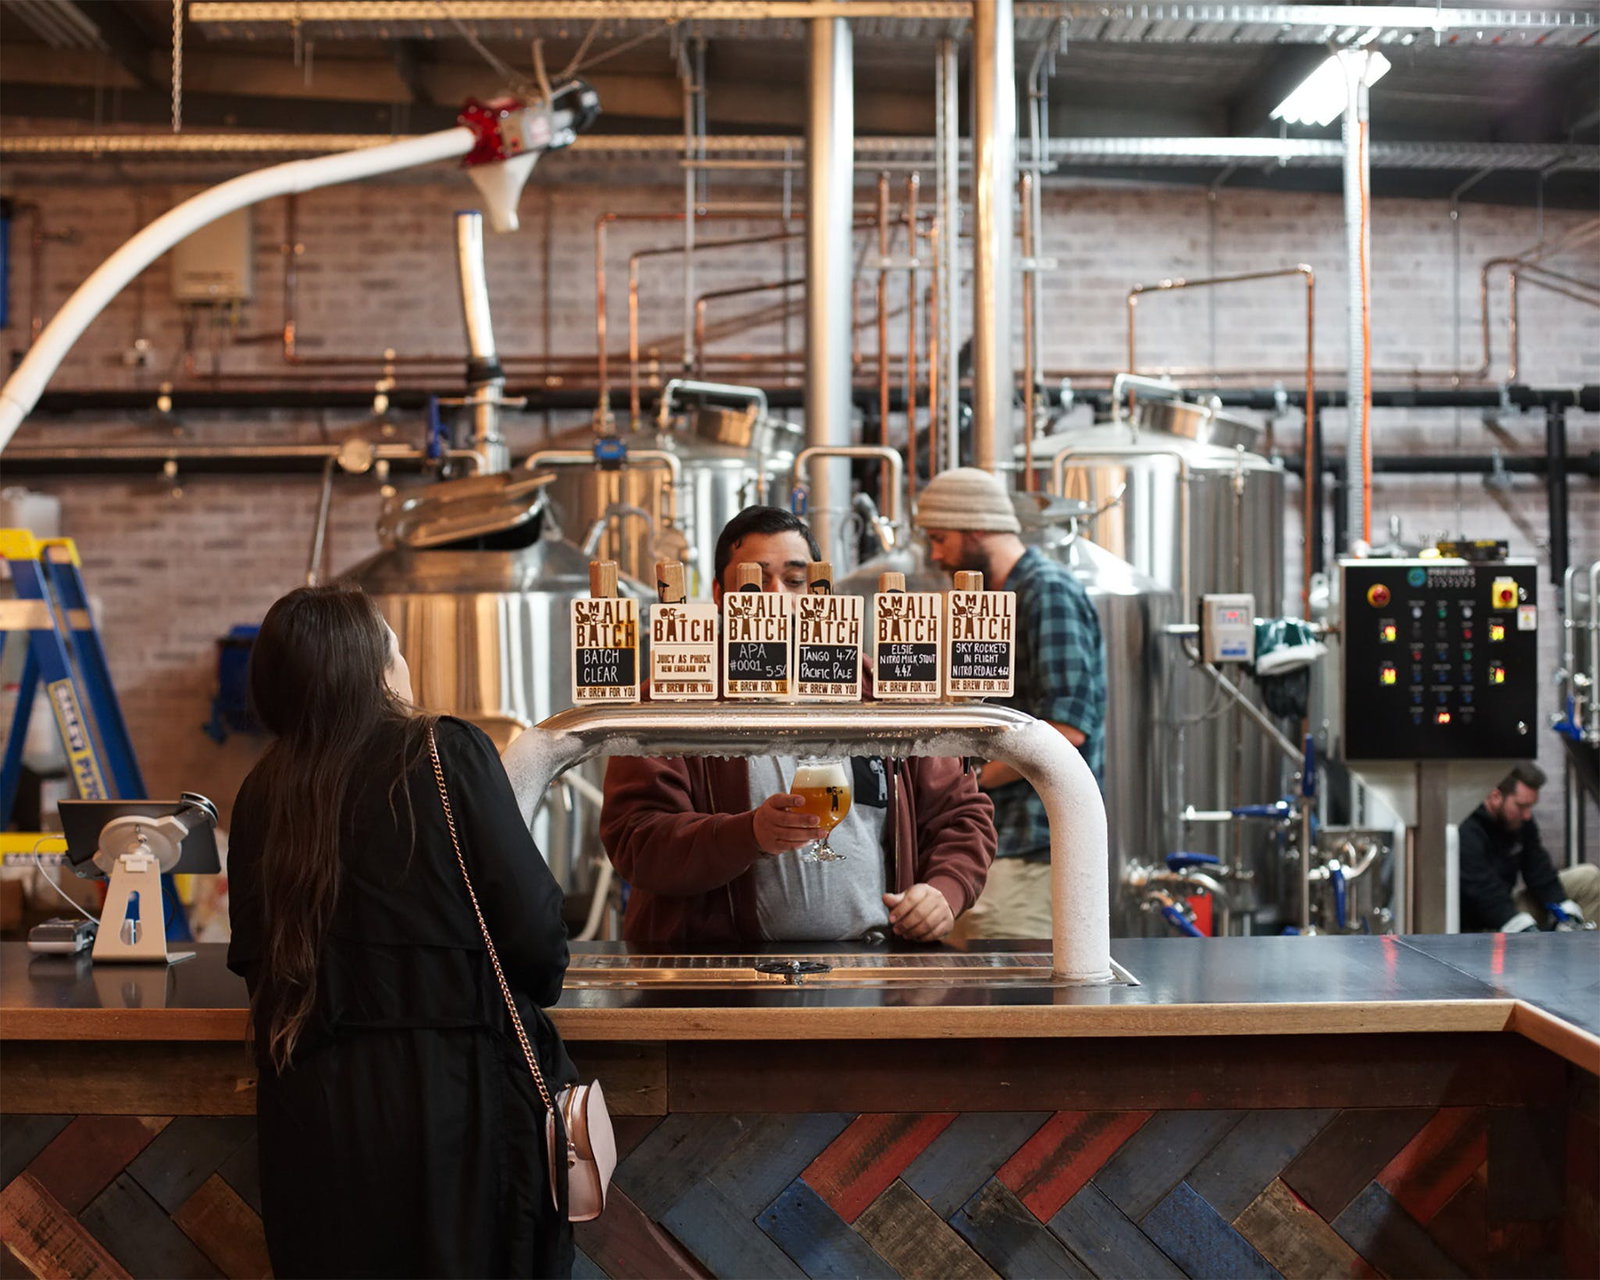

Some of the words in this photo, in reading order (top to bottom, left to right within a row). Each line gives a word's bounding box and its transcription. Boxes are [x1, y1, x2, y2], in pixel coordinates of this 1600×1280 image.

[728, 595, 787, 618] SMALL
[800, 597, 859, 621] SMALL
[878, 596, 937, 619] SMALL
[952, 594, 1011, 617] SMALL
[575, 601, 635, 625] SMALL
[576, 624, 635, 647] BATCH
[654, 619, 714, 642] BATCH
[729, 618, 787, 641] BATCH
[800, 620, 858, 644] BATCH
[879, 619, 937, 642] BATCH
[952, 617, 1011, 640] BATCH
[739, 643, 767, 659] APA
[891, 644, 914, 655] ELSIE
[956, 643, 973, 654] SKY
[974, 643, 1007, 654] ROCKETS
[583, 649, 620, 665] BATCH
[678, 654, 687, 664] AS
[879, 655, 900, 664] NITRO
[901, 655, 918, 666] MILK
[918, 654, 936, 664] STOUT
[963, 654, 972, 663] IN
[974, 654, 999, 663] FLIGHT
[661, 665, 672, 673] NEW
[729, 659, 762, 672] #0001
[952, 665, 973, 676] NITRO
[973, 666, 985, 676] RED
[985, 666, 997, 676] ALE
[583, 666, 619, 683] CLEAR
[654, 683, 664, 693] WE
[666, 683, 685, 693] BREW
[687, 683, 699, 693] FOR
[701, 683, 714, 693] YOU
[728, 681, 738, 692] WE
[740, 681, 758, 692] BREW
[760, 681, 773, 692] FOR
[775, 681, 787, 692] YOU
[798, 683, 808, 694] WE
[810, 683, 828, 694] BREW
[830, 684, 843, 694] FOR
[845, 684, 858, 695] YOU
[878, 682, 887, 692] WE
[890, 682, 908, 692] BREW
[910, 682, 922, 692] FOR
[925, 682, 937, 692] YOU
[951, 680, 960, 690] WE
[962, 680, 980, 690] BREW
[982, 680, 995, 690] FOR
[997, 680, 1010, 690] YOU
[576, 687, 586, 698] WE
[589, 687, 607, 698] BREW
[609, 687, 621, 698] FOR
[623, 687, 636, 697] YOU
